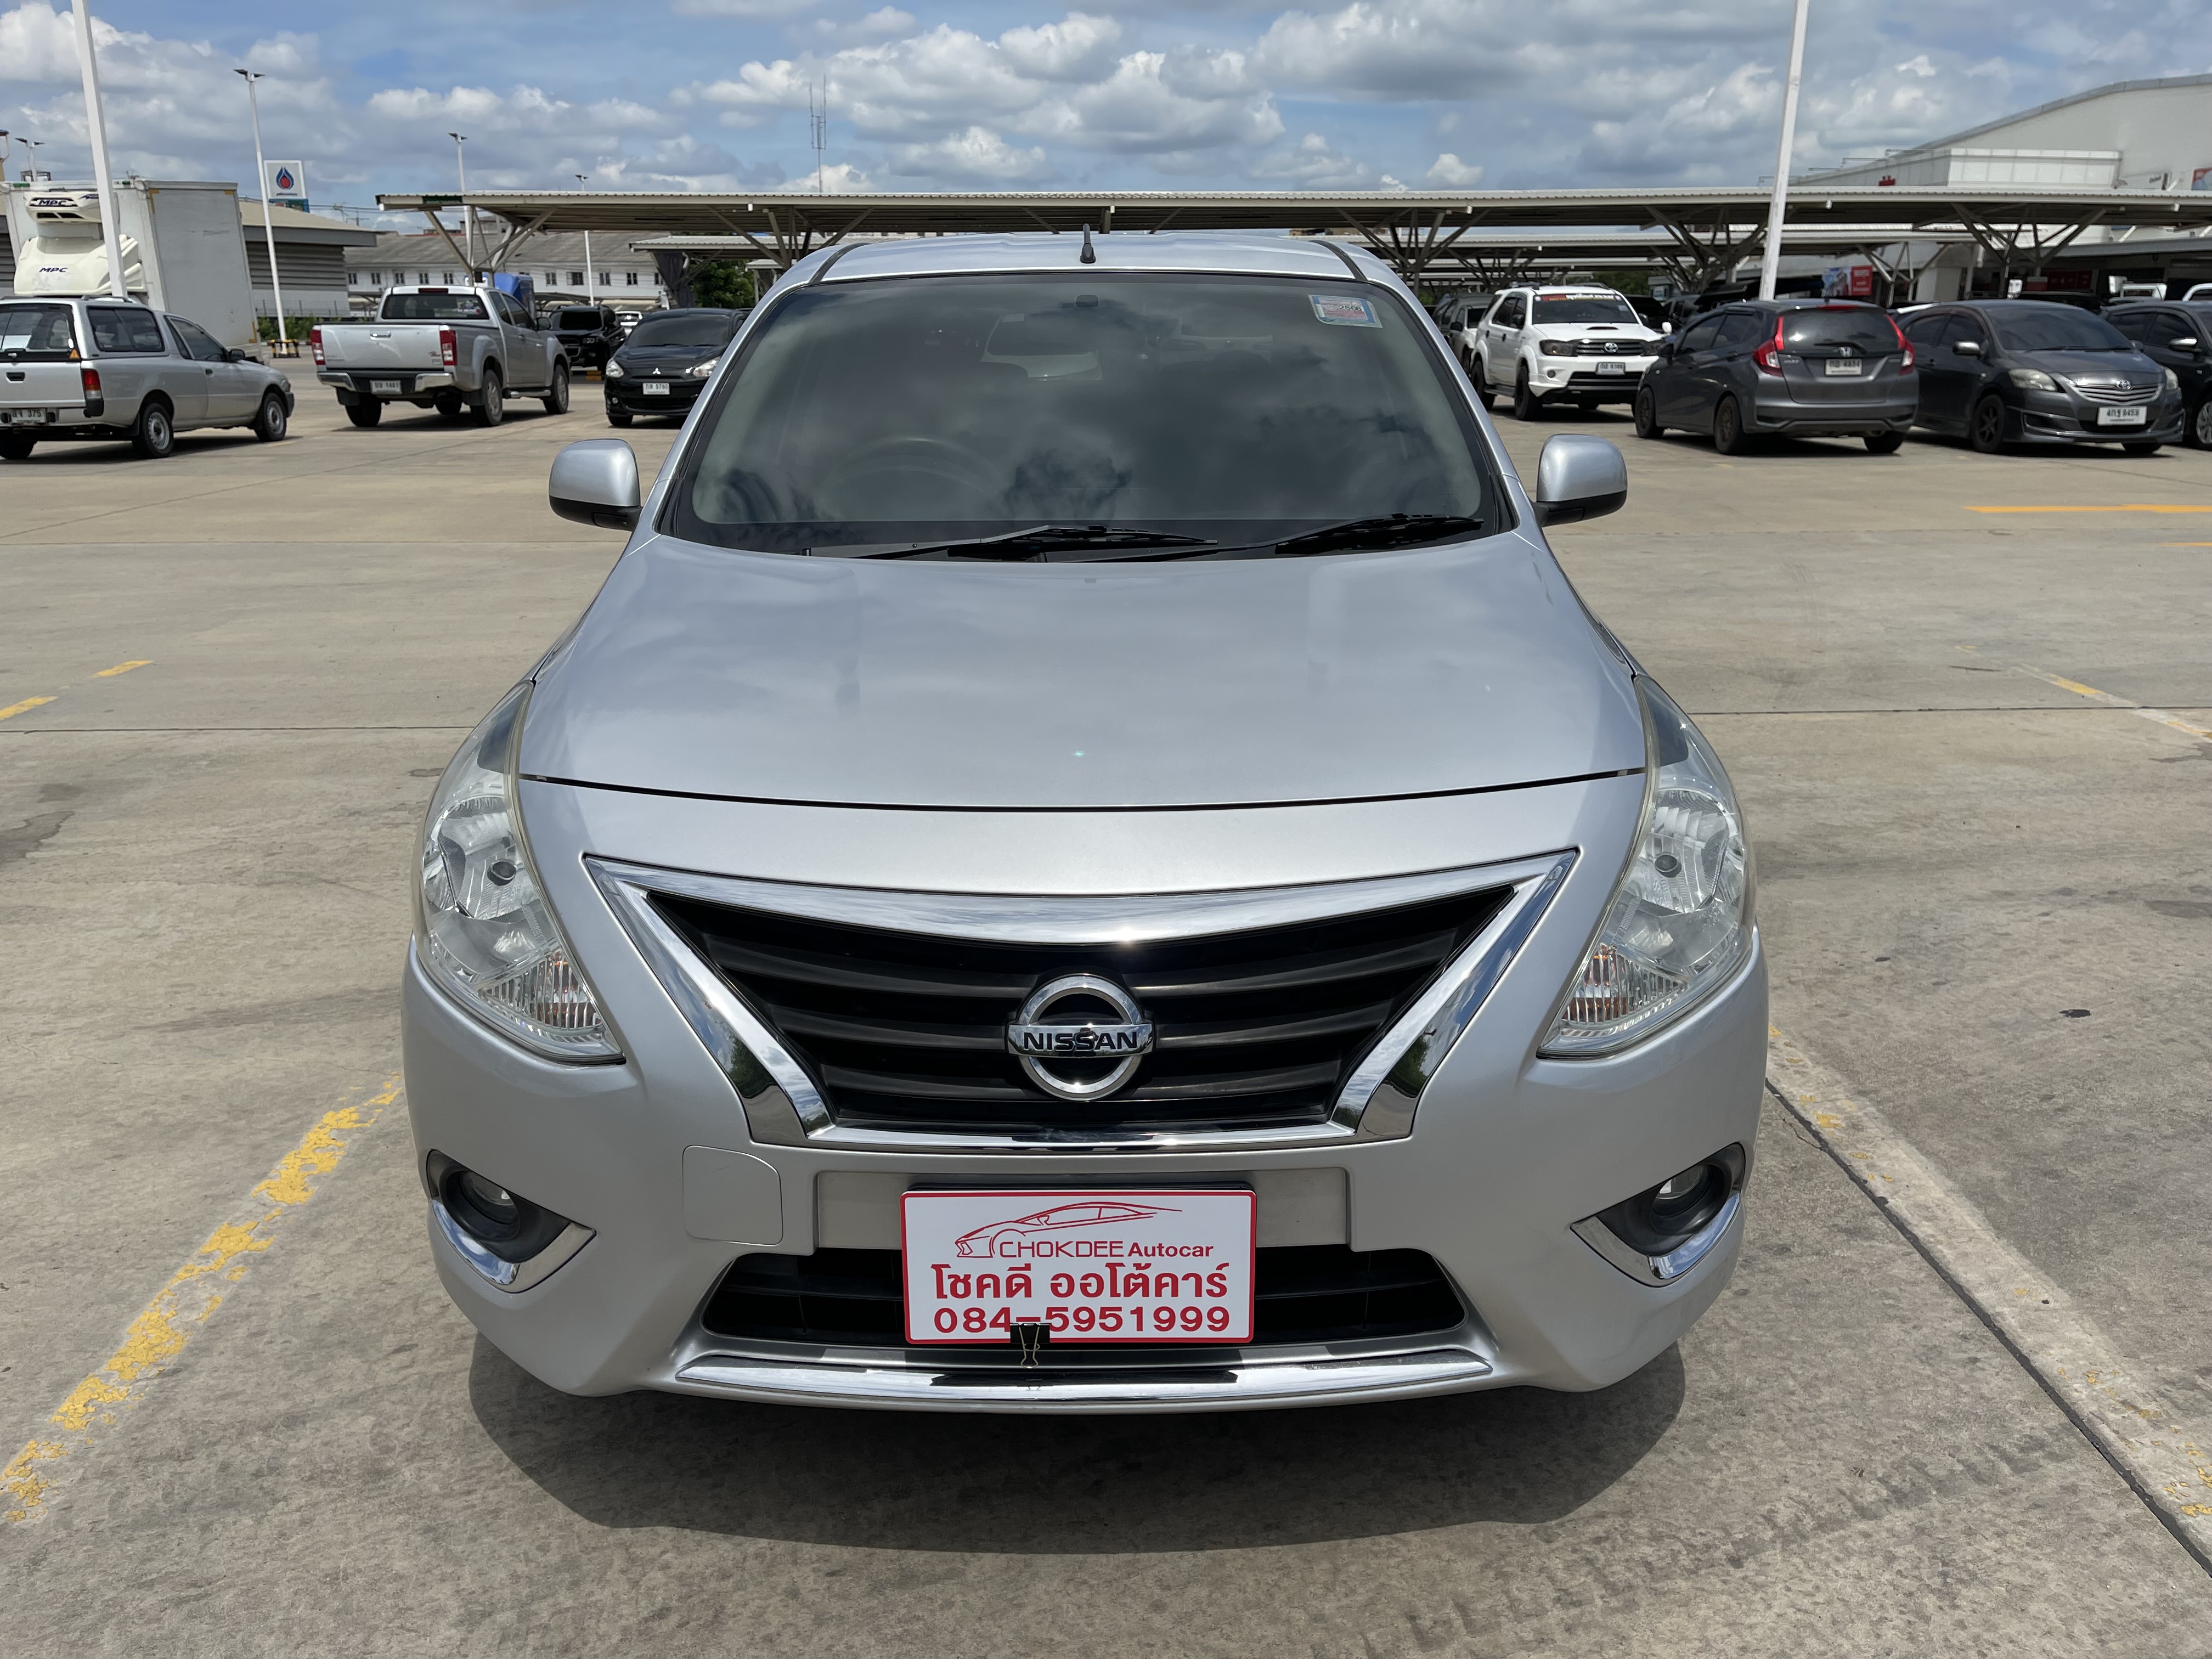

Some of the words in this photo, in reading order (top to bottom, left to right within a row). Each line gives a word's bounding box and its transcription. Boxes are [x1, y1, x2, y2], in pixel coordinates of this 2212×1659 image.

[1023, 1031, 1137, 1052] NISSAN
[999, 1240, 1124, 1258] CHOKDEE
[1127, 1242, 1214, 1257] Autocar
[930, 1263, 1032, 1299] โชคดี
[1050, 1262, 1229, 1298] ออโต้คาร์
[934, 1306, 1230, 1333] 084-5951999
